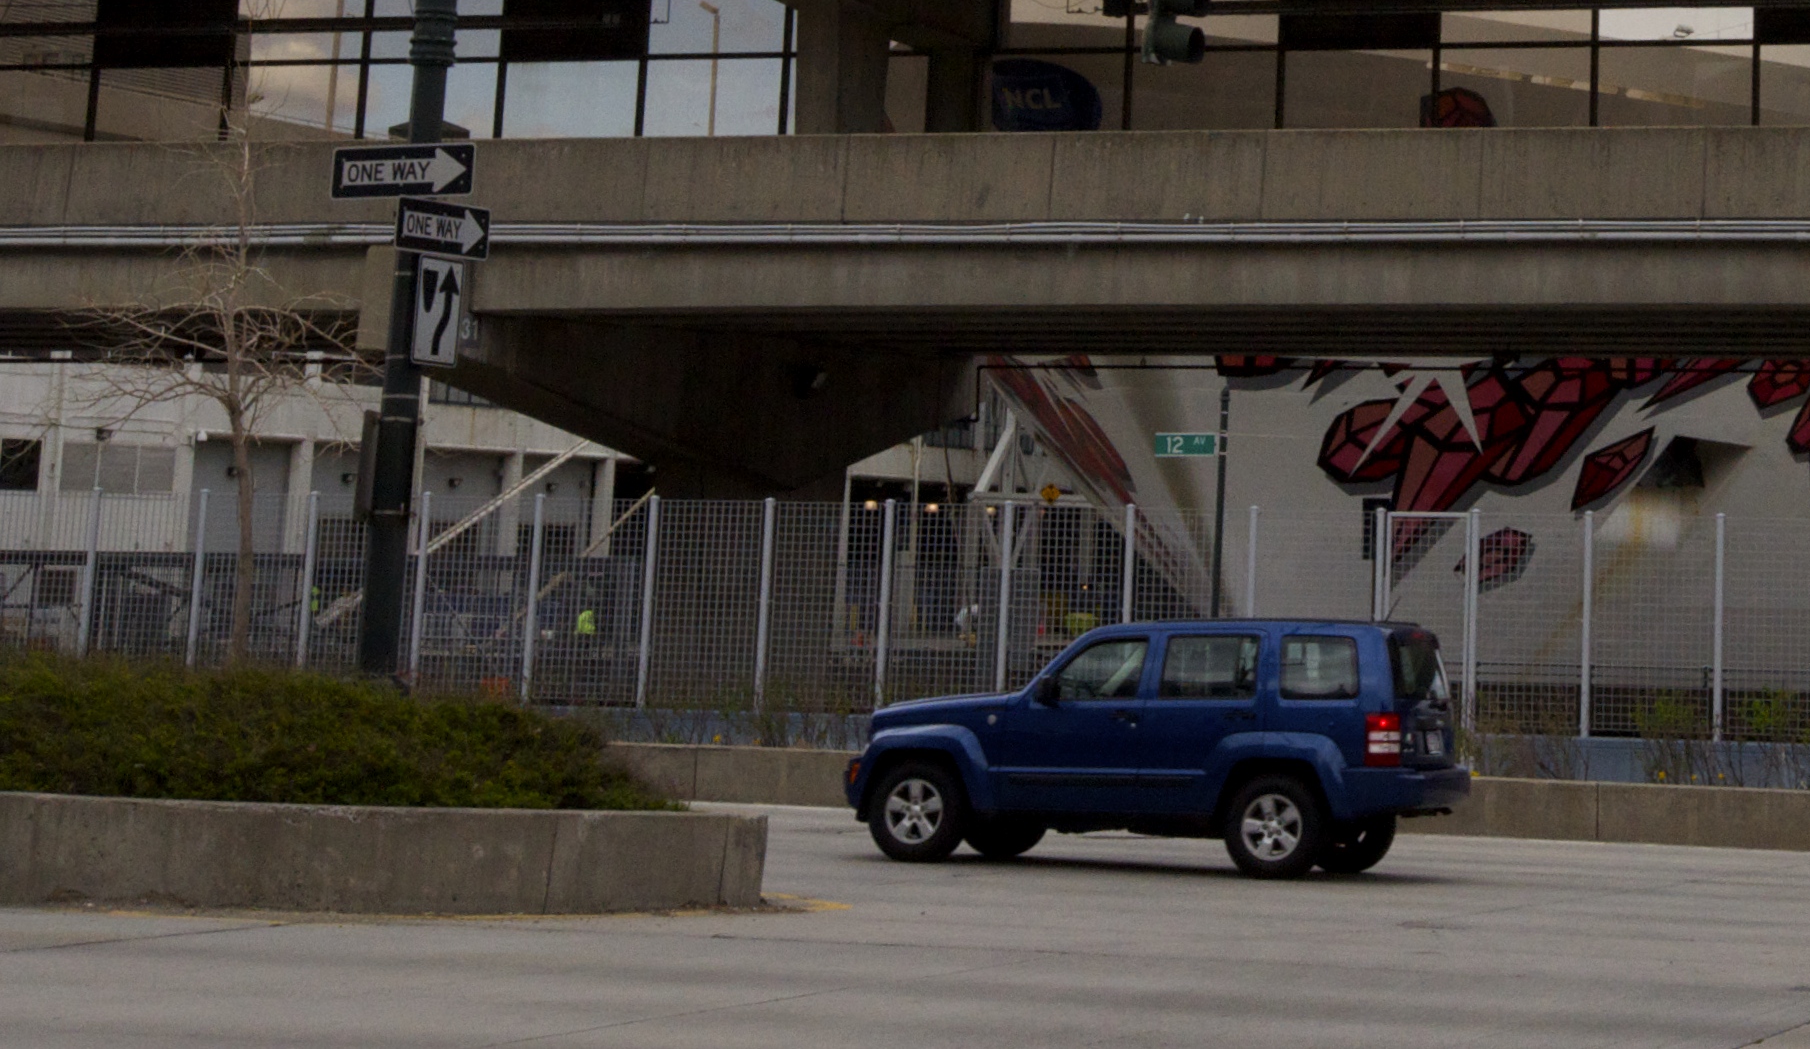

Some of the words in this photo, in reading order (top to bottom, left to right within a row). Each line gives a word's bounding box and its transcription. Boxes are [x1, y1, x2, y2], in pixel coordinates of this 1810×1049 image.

[347, 163, 385, 183] ONE
[392, 161, 431, 181] WAY
[406, 213, 433, 235] ONE
[436, 217, 463, 240] WAY
[461, 317, 479, 341] 31
[1166, 436, 1184, 454] 12
[1193, 436, 1206, 445] AV
